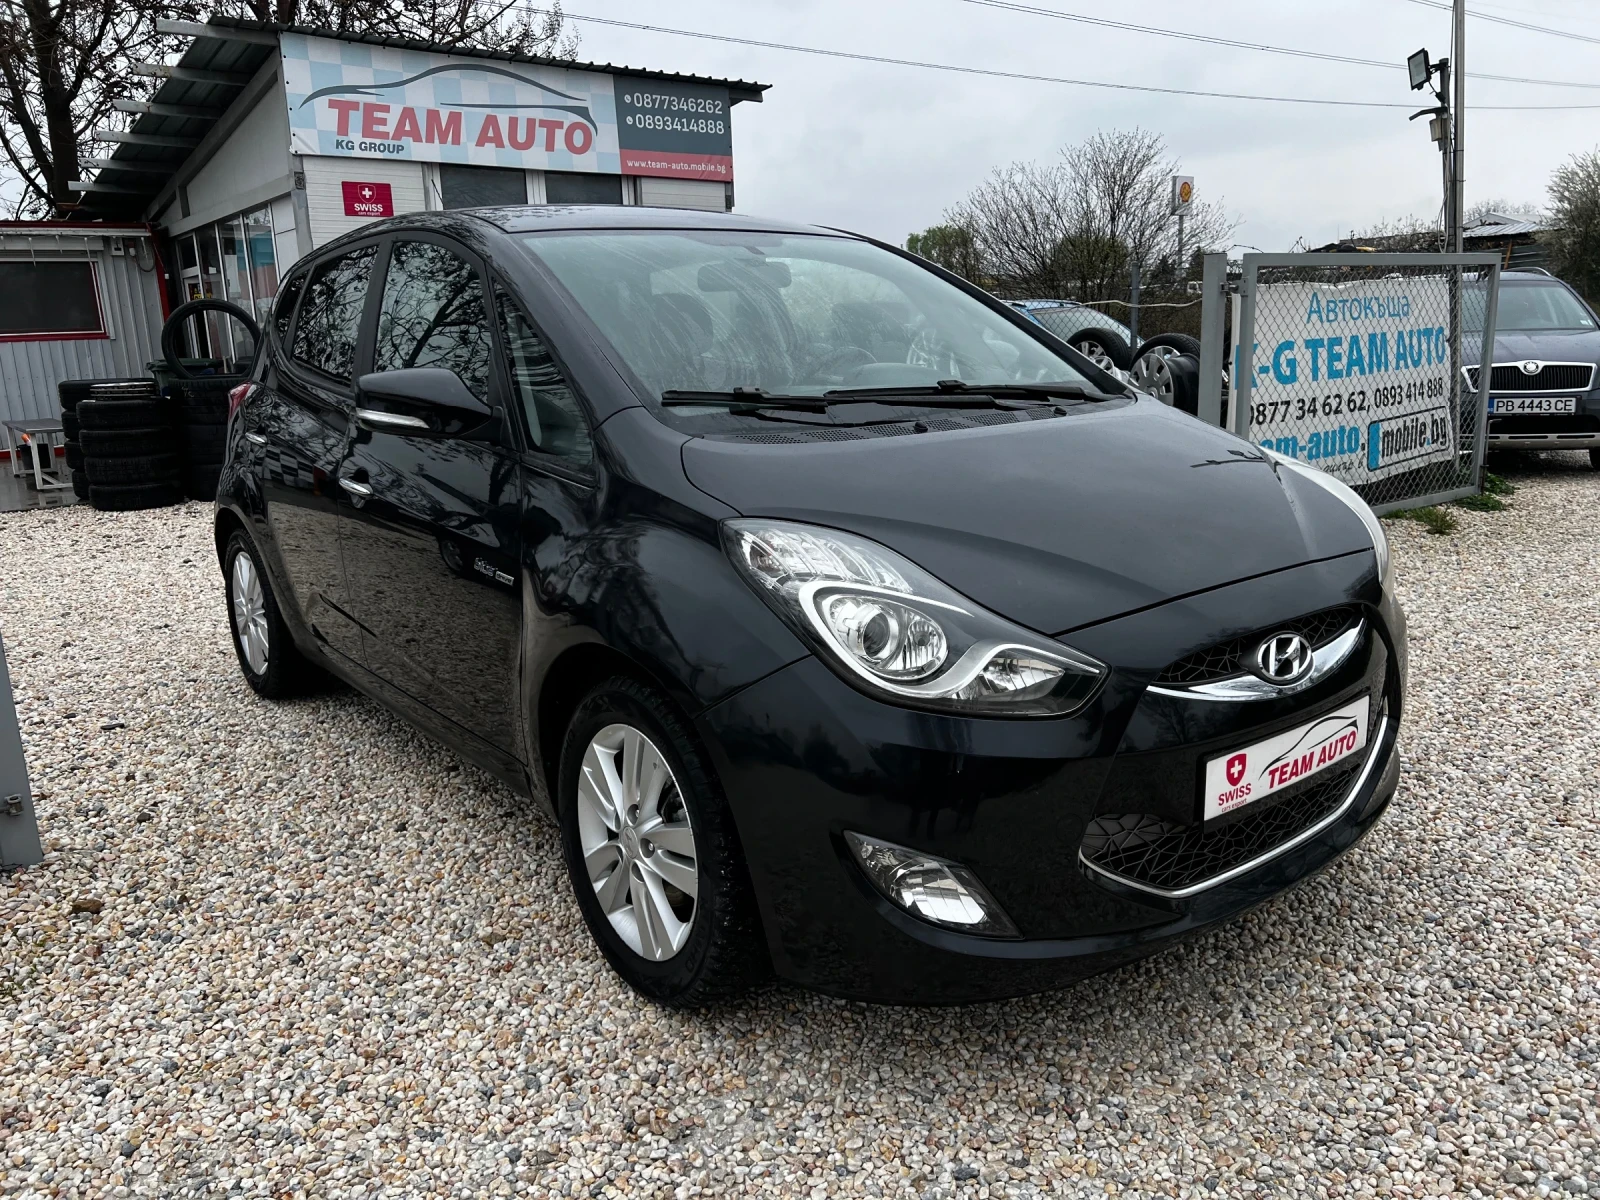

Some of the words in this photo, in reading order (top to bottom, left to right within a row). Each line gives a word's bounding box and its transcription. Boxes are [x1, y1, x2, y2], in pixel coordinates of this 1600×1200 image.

[634, 92, 723, 115] 0877346262
[328, 98, 463, 146] TEAM
[475, 113, 593, 156] AUTO
[635, 113, 725, 135] 0893414888
[335, 139, 355, 151] KG
[358, 141, 405, 154] GROUP
[626, 159, 726, 174] www.team-auto.mobile.bg
[354, 203, 383, 212] SWISS
[1304, 332, 1389, 382] TEAM
[1394, 326, 1446, 371] AUTO
[1295, 397, 1318, 421] 34
[1321, 393, 1343, 417] 62
[1347, 390, 1371, 414] 62,
[1374, 386, 1403, 409] 0893
[1405, 382, 1425, 403] 414
[1427, 377, 1443, 399] 888
[1496, 400, 1515, 412] PB
[1517, 400, 1552, 412] 4443
[1554, 400, 1573, 412] CE
[1381, 413, 1447, 459] mobile.bg
[1268, 750, 1315, 790] TEAM
[1316, 730, 1357, 768] AUTO
[1218, 783, 1251, 806] SWISS
